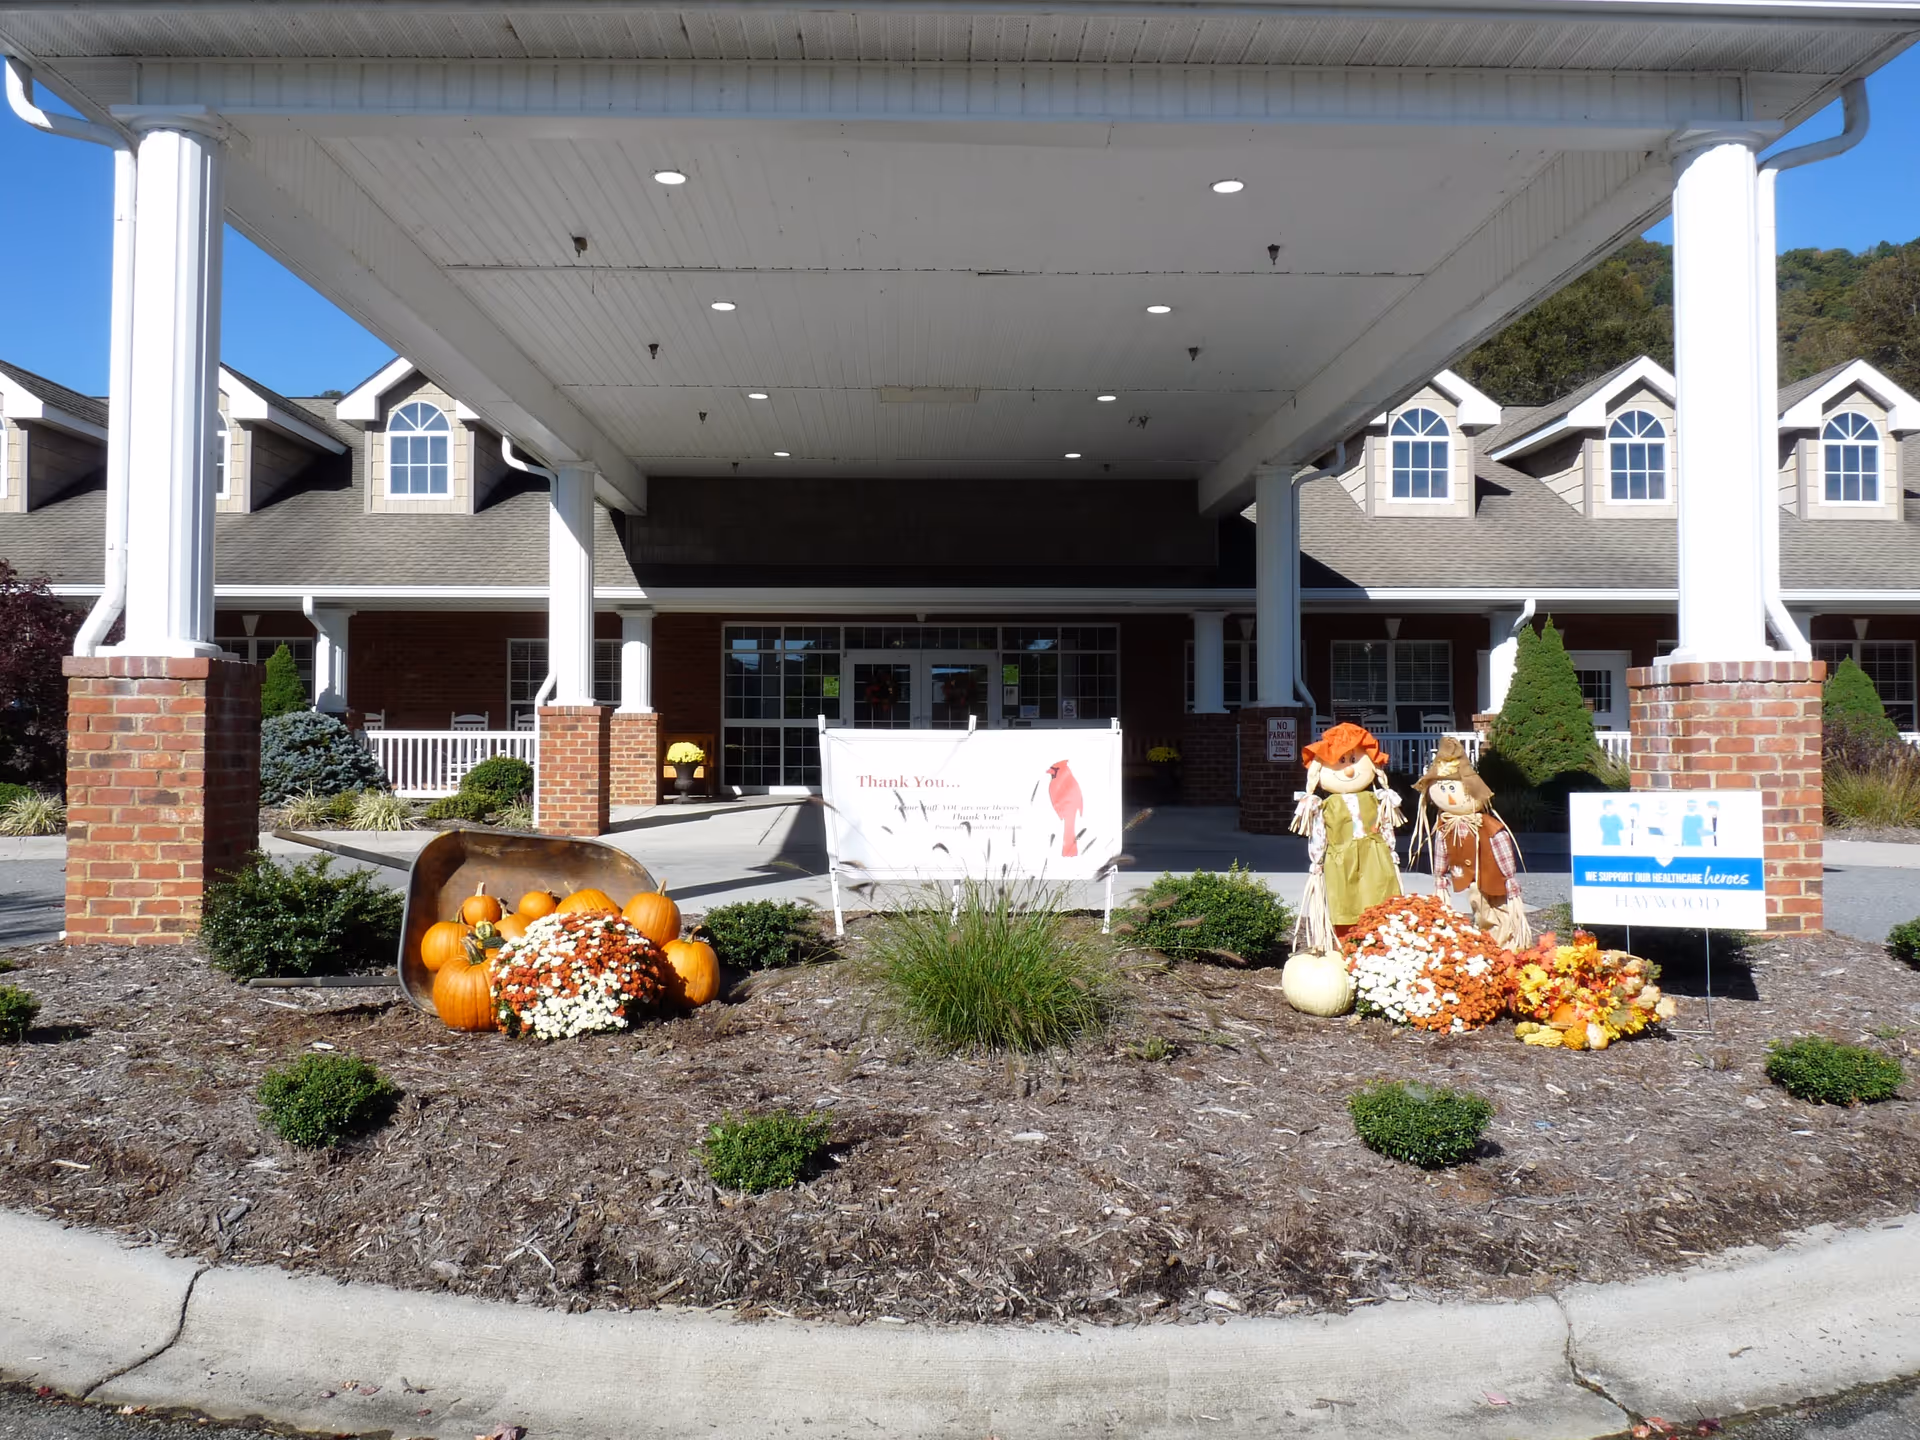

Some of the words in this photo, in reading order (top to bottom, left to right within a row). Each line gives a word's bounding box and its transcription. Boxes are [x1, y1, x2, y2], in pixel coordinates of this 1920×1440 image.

[1276, 721, 1288, 730] NO
[1268, 731, 1296, 740] PARKING
[856, 774, 909, 788] Thank
[913, 775, 961, 788] You...
[953, 812, 980, 821] Thank
[1584, 871, 1597, 882] WE
[1598, 872, 1633, 883] SUPPORT
[1634, 872, 1651, 883] OUR
[1652, 873, 1702, 884] HEALTHCARE
[1704, 866, 1749, 885] heroes
[1615, 894, 1720, 911] HAYWOOD
